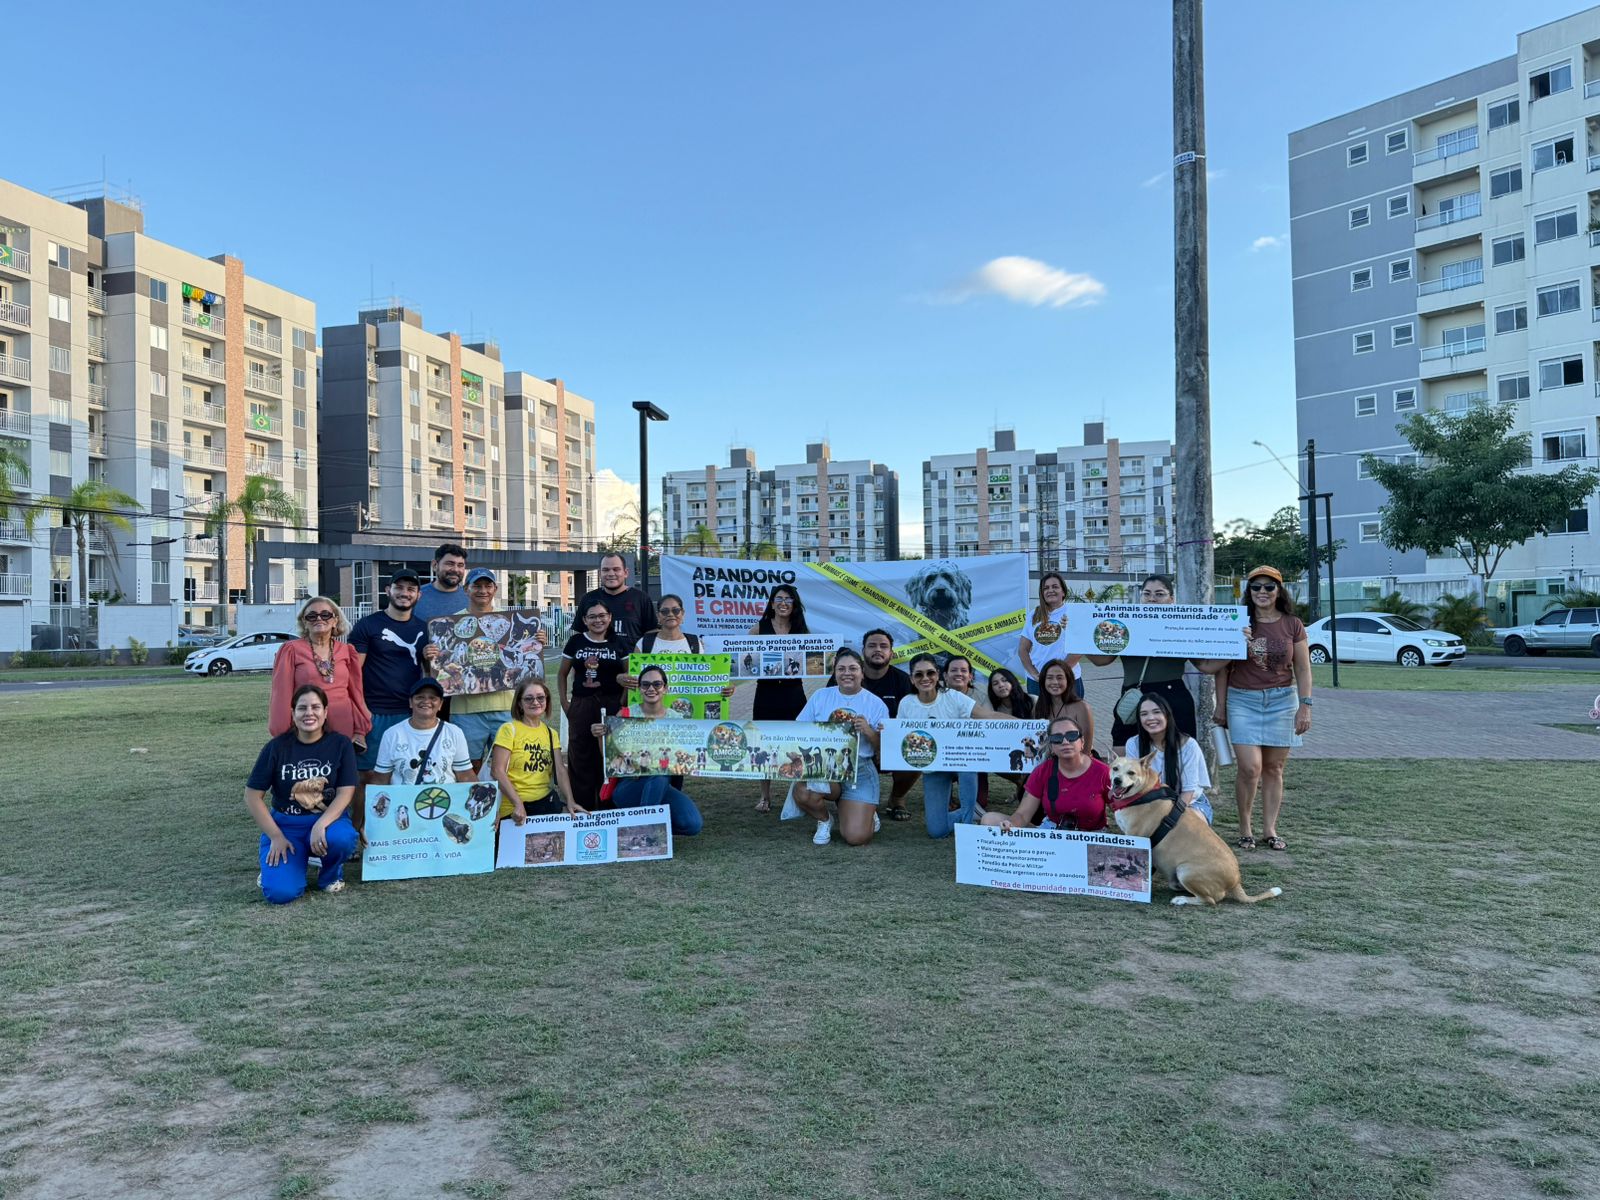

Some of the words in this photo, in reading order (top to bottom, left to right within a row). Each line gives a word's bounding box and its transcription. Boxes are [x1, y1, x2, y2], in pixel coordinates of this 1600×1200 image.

[692, 566, 796, 584] ABANDONO
[693, 582, 716, 598] DE
[822, 563, 842, 577] ANIMAIS
[843, 576, 859, 587] CRIME
[862, 586, 889, 605] ABANDONO
[888, 601, 896, 610] DE
[896, 605, 917, 622] ANIMAIS
[920, 620, 938, 634] CRIME
[939, 633, 966, 653] ABANDONO
[966, 650, 974, 658] DE
[985, 624, 994, 632] DE
[994, 616, 1018, 630] ANIMAIS
[576, 649, 616, 660] Garfield
[900, 721, 928, 729] PARQUE
[930, 721, 961, 729] MOSAICO
[964, 721, 982, 729] PEDE
[984, 721, 1019, 730] SOCORRO
[1021, 722, 1046, 730] PELOS
[281, 764, 331, 780] Fiapo
[586, 810, 625, 821] urgentes
[628, 807, 656, 816] contra
[572, 818, 619, 828] abandono!
[1000, 828, 1046, 838] Pedimos
[1050, 831, 1062, 839] às
[1066, 832, 1135, 846] autoridades:
[392, 853, 428, 861] RESPEITO
[990, 880, 1011, 888] Chega
[1023, 882, 1066, 892] impunidade
[1068, 886, 1086, 894] para
[1088, 888, 1134, 899] maus-tratos!
